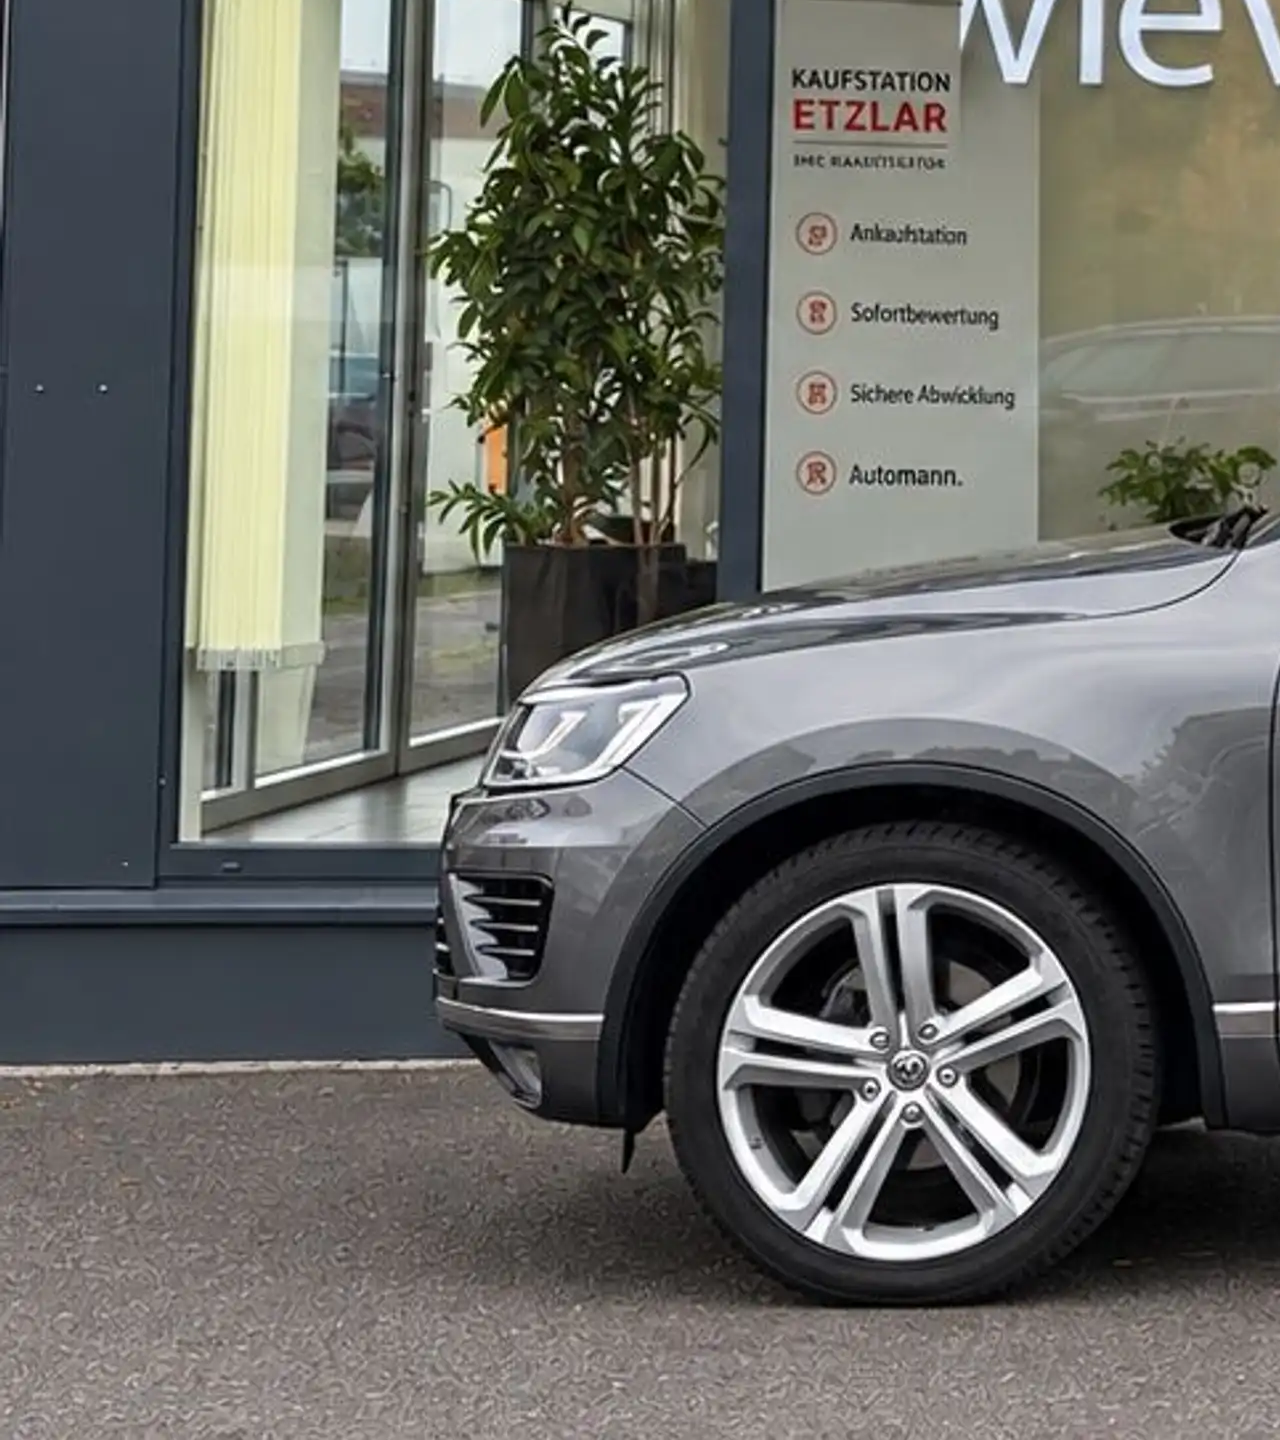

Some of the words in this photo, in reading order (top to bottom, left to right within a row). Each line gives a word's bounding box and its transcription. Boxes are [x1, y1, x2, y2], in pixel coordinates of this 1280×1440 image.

[792, 68, 950, 92] KAUFSTATION
[793, 99, 948, 132] ETZLAR
[850, 302, 999, 331] Sofortbewertung
[850, 383, 914, 405] Sichere
[917, 384, 1016, 411] Abwicklung
[848, 465, 963, 487] Automann.
